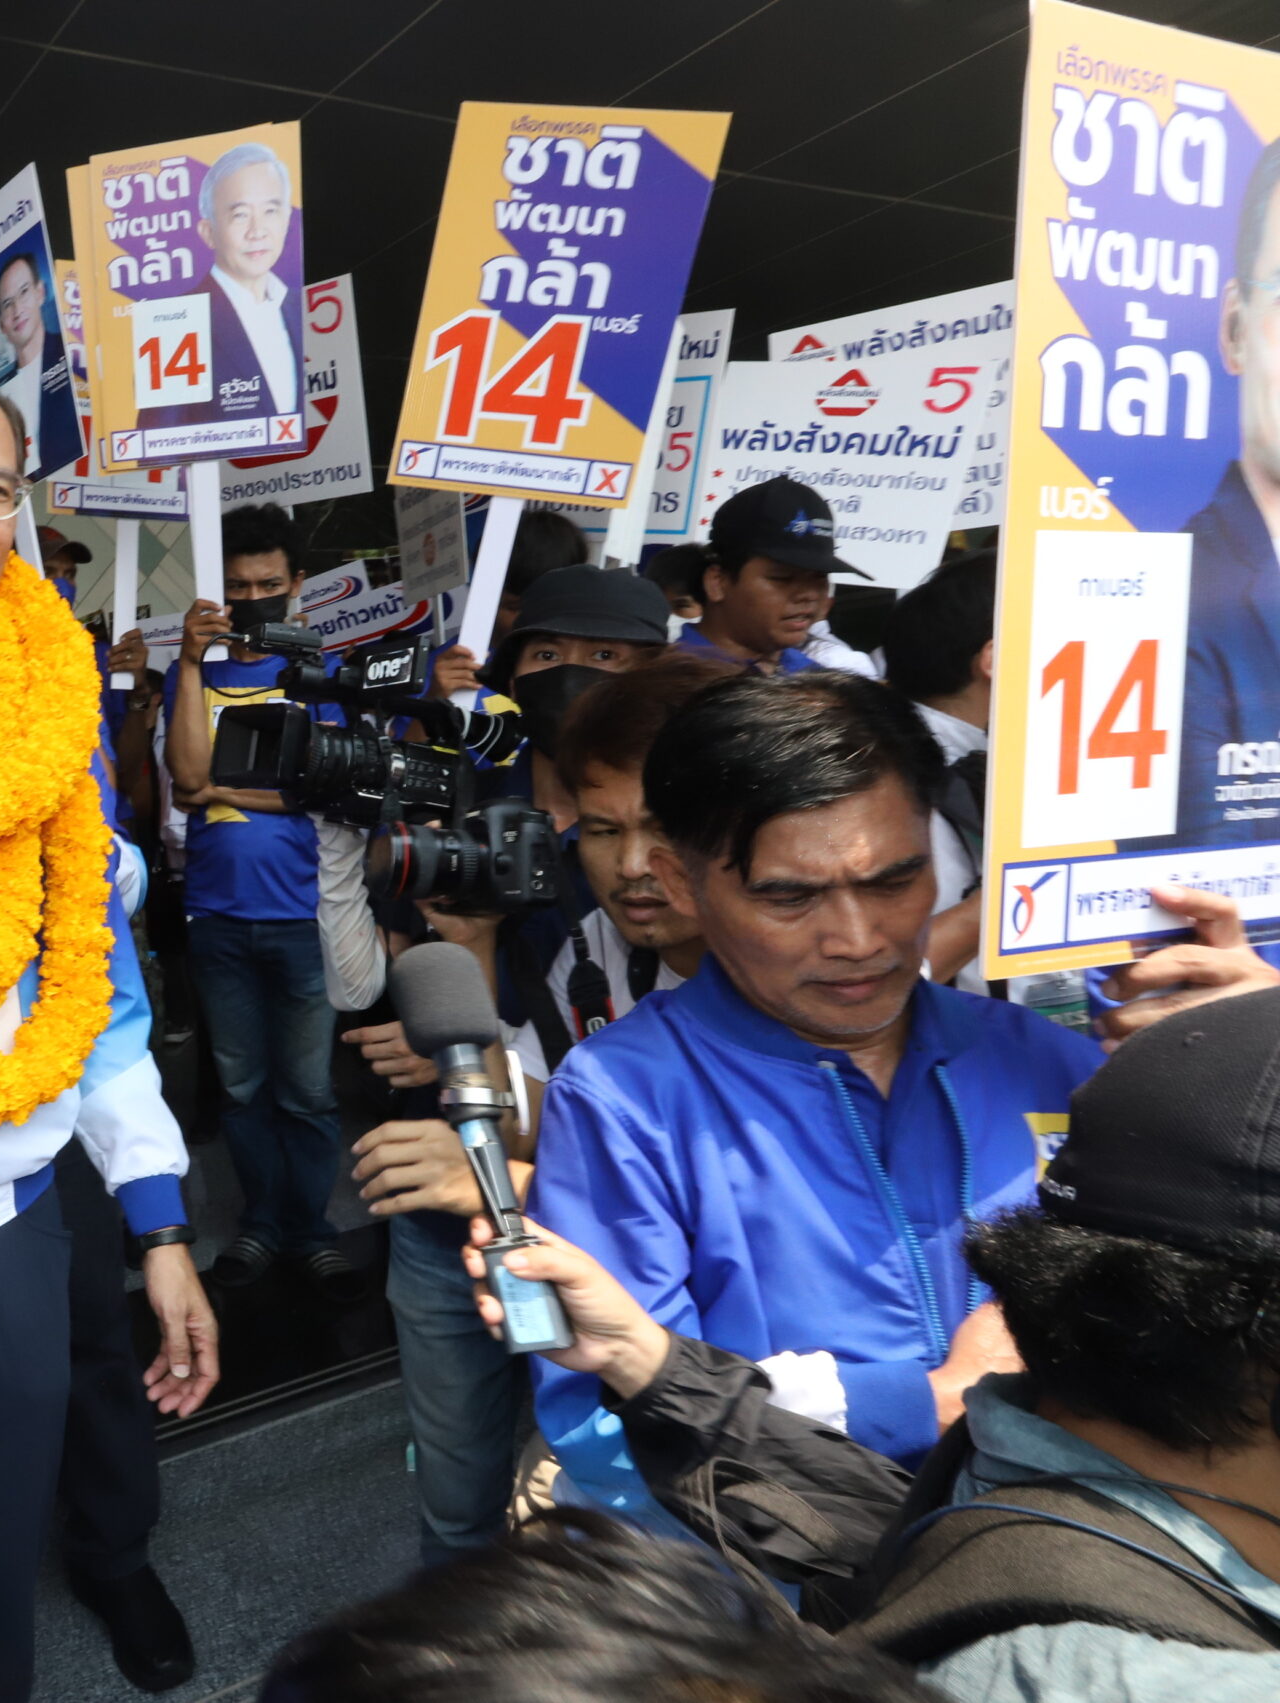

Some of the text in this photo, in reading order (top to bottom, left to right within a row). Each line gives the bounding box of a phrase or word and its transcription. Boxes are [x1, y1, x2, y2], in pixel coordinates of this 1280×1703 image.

[1056, 44, 1169, 97] เลือกพรรค
[511, 114, 596, 135] เลือกพรรค
[1052, 79, 1228, 208] ชาติ
[502, 123, 646, 190] ชาติ
[102, 155, 191, 209] ชาติ
[106, 208, 192, 240] พัฒนา
[495, 187, 627, 237] พัฒนา
[107, 237, 195, 289] กล้า
[1046, 196, 1220, 300] พัฒนา
[478, 238, 612, 309] กล้า
[306, 280, 344, 334] 5
[592, 313, 643, 335] เบอร์
[137, 332, 207, 390] 14
[426, 310, 593, 449] 14
[1039, 301, 1211, 440] กล้า
[219, 375, 261, 398] สุวัจน์
[922, 366, 982, 414] 5
[147, 425, 263, 449] พรรคชาติพัฒนากล้า
[666, 431, 694, 473] 5
[721, 420, 965, 459] พลังสังคมใหม่
[440, 455, 582, 484] พรรคชาติพัฒนากล้า
[735, 464, 948, 492] ปาก้องต้องมาก่อน
[1038, 476, 1115, 520] เบอร์
[1078, 570, 1148, 598] กาเบอร์
[1040, 638, 1169, 796] 14
